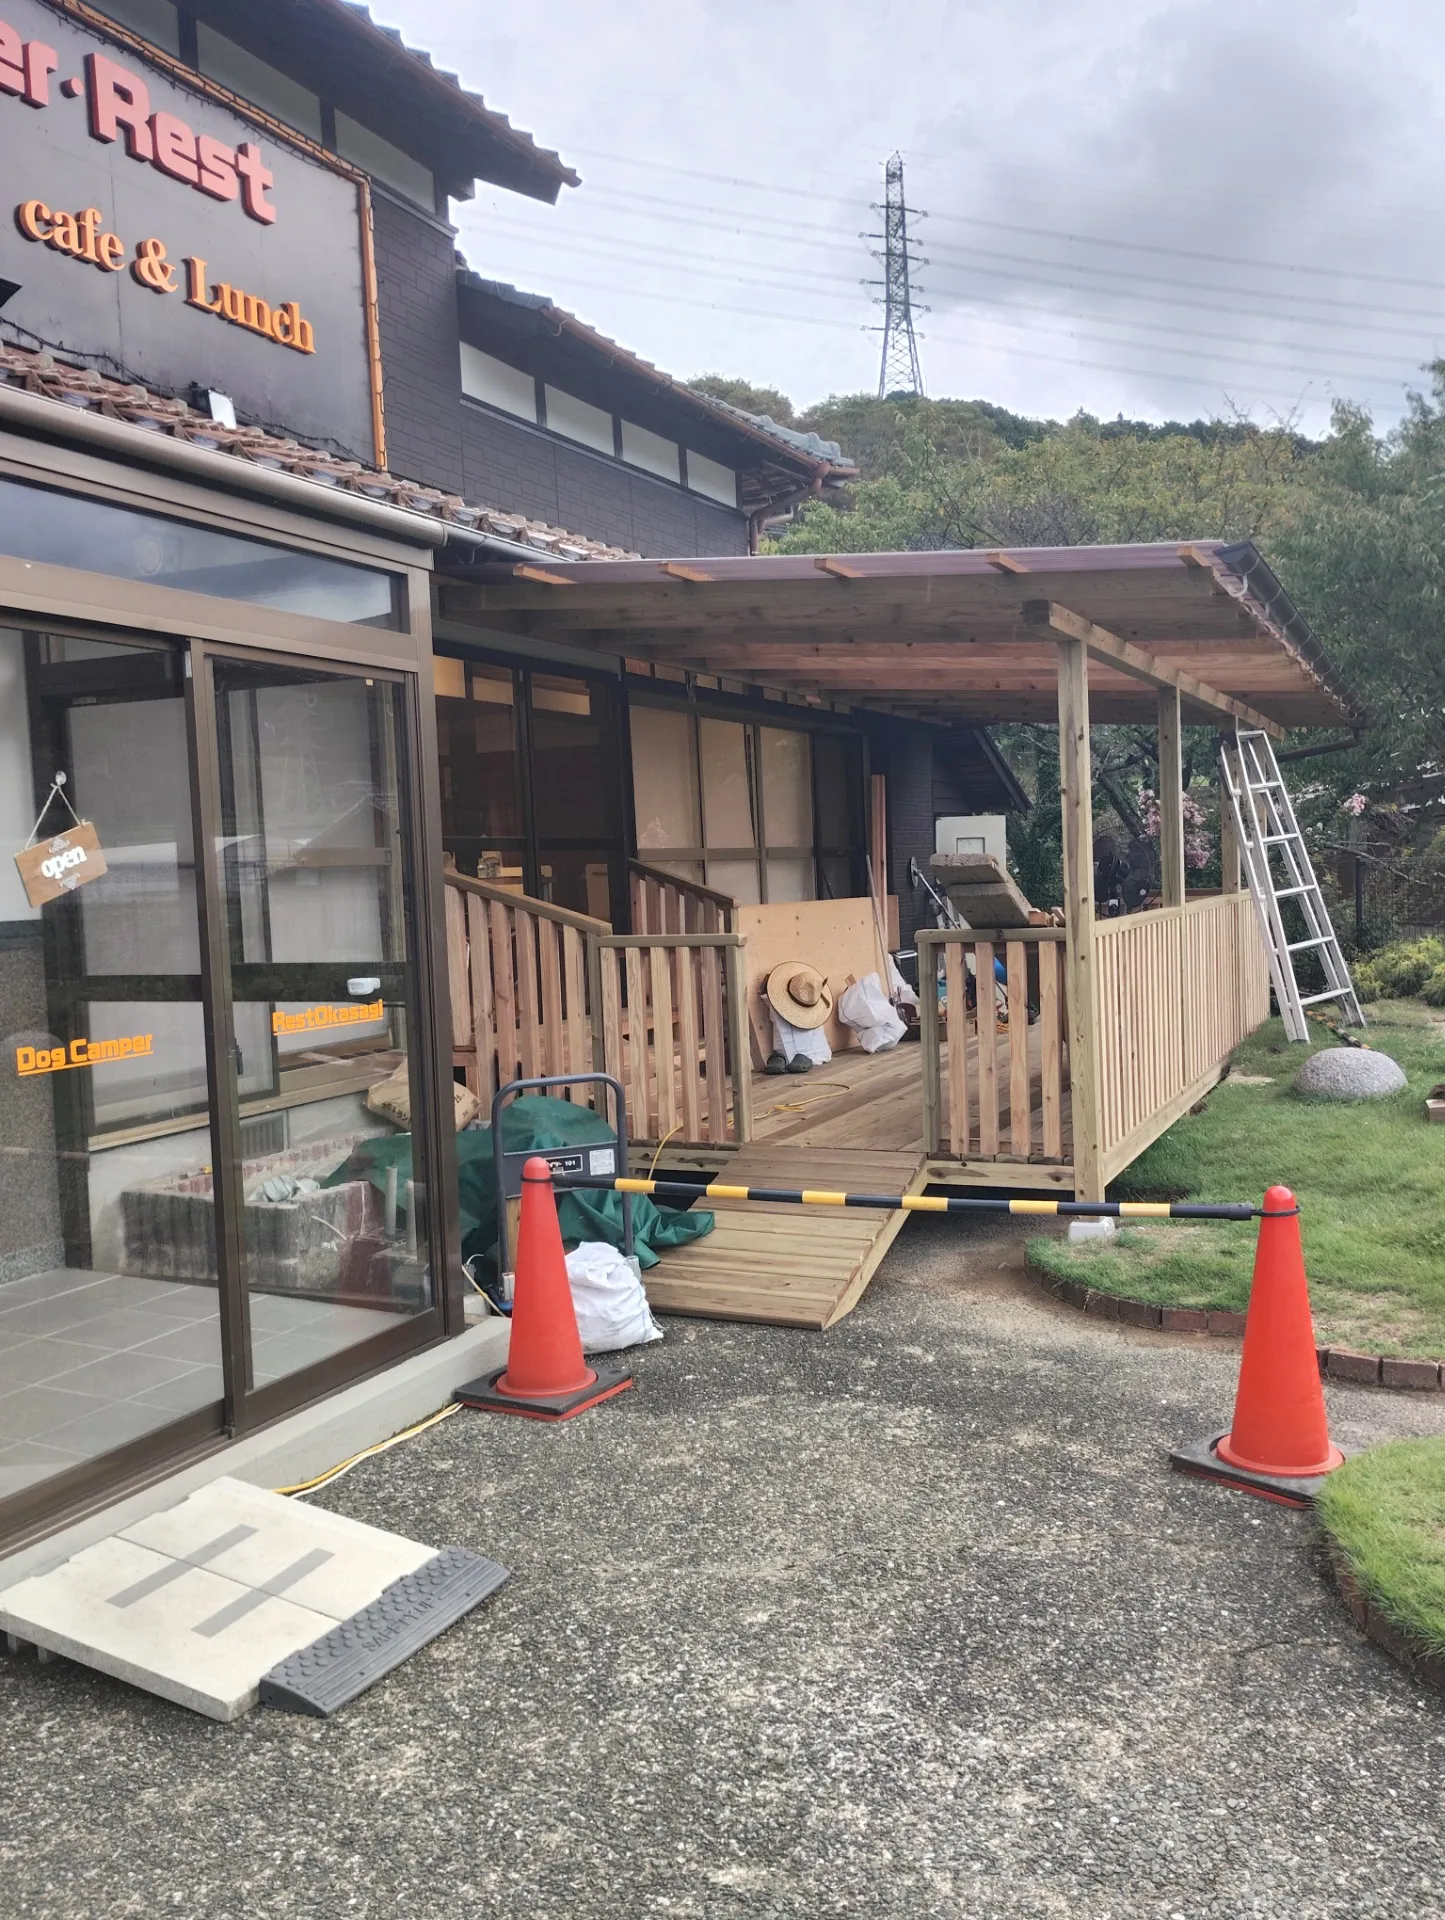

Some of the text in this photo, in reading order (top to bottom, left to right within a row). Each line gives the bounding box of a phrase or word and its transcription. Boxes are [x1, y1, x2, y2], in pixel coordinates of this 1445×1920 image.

[19, 200, 317, 355] cafe & Lunch
[41, 846, 88, 879] open
[16, 1034, 153, 1072] Dog Camper
